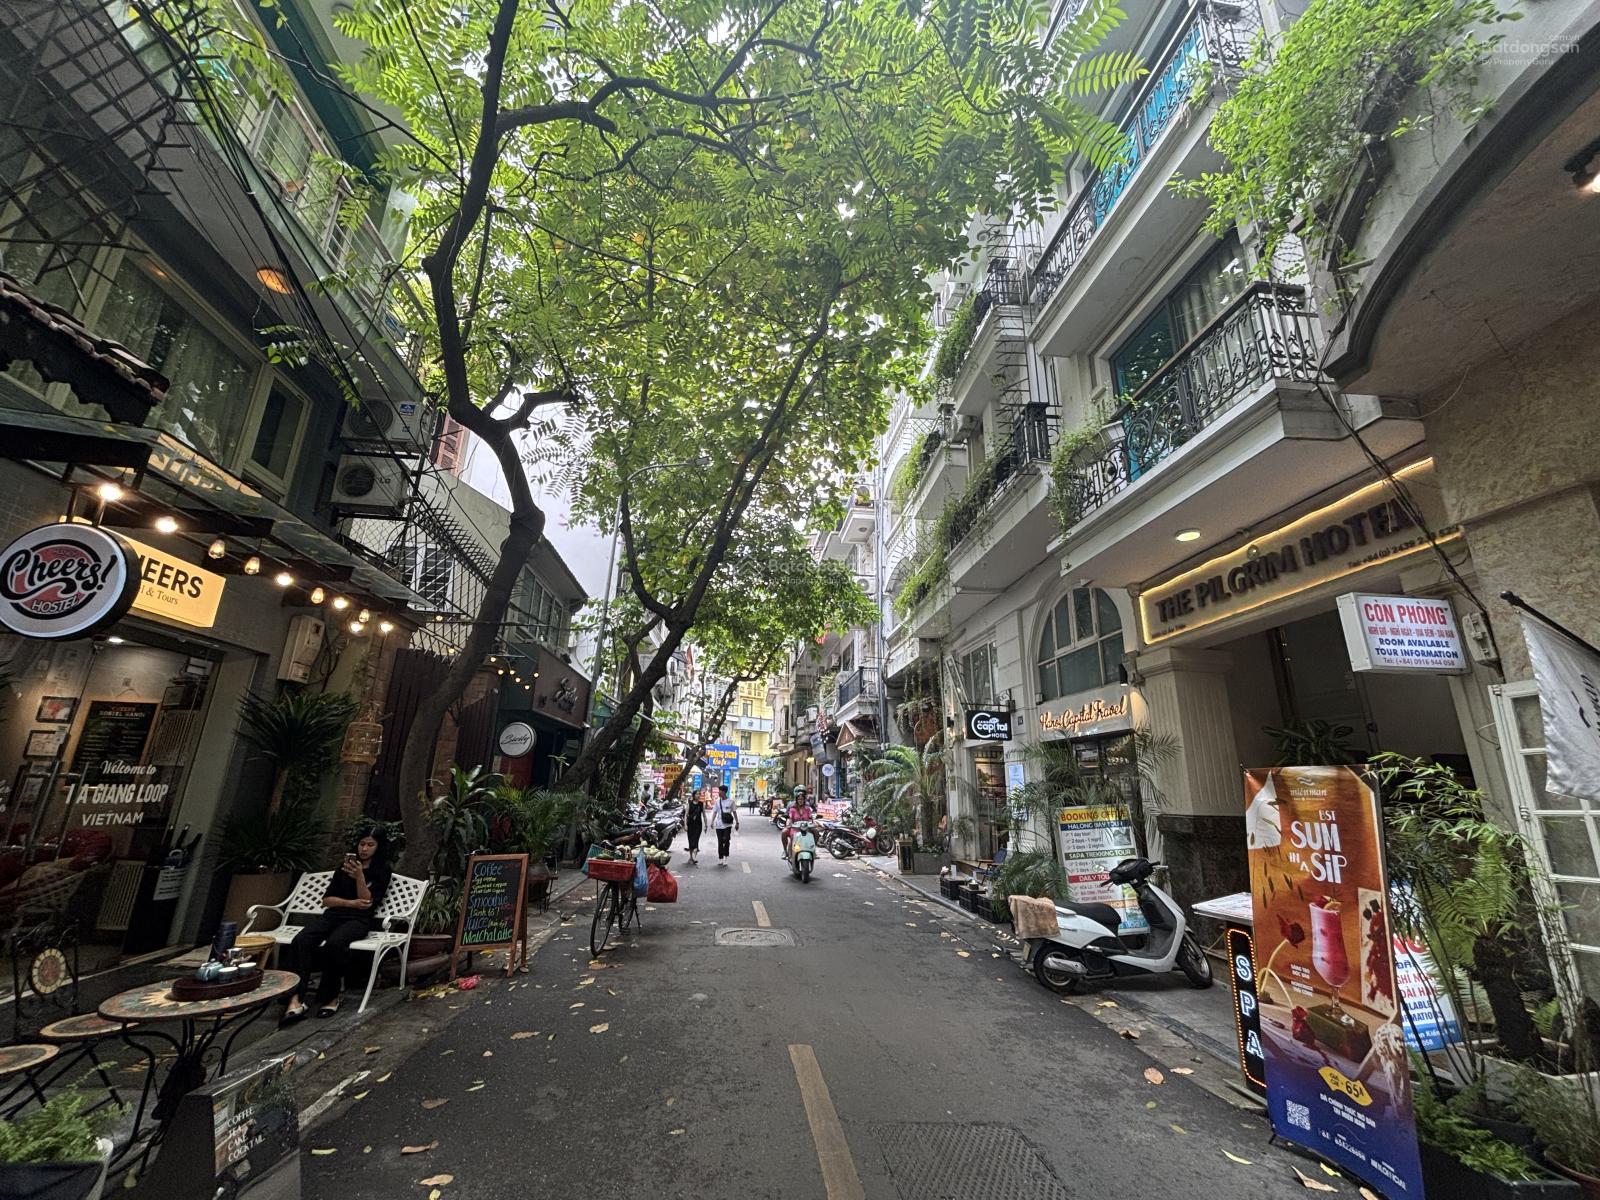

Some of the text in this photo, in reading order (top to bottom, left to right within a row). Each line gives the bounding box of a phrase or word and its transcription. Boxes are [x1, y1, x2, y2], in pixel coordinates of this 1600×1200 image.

[0, 548, 118, 600] Cheers!
[1155, 586, 1195, 623] THE
[1195, 544, 1298, 609] PILGRIM
[32, 594, 80, 614] HOSTEL
[157, 589, 178, 605] Tours
[1364, 599, 1448, 625] CÒN PHÒNG
[1378, 638, 1450, 648] ROOM AVAILABLE
[1375, 647, 1458, 658] TOUR INFORMATION
[1063, 702, 1094, 733] Capital
[1094, 694, 1128, 721] Travel
[100, 760, 157, 775] Welcome to
[92, 784, 137, 804] GIANG
[136, 783, 169, 803] LOOP
[81, 811, 145, 827] VIETNAM
[1060, 811, 1099, 822] BOOKING
[1067, 822, 1093, 830] HALONG
[1290, 820, 1342, 852] SUM
[473, 862, 503, 876] Coffee
[1097, 873, 1111, 881] TOU
[1235, 954, 1265, 1060] SPA
[227, 1105, 256, 1128] COFFEE
[227, 1133, 249, 1150] CAKE
